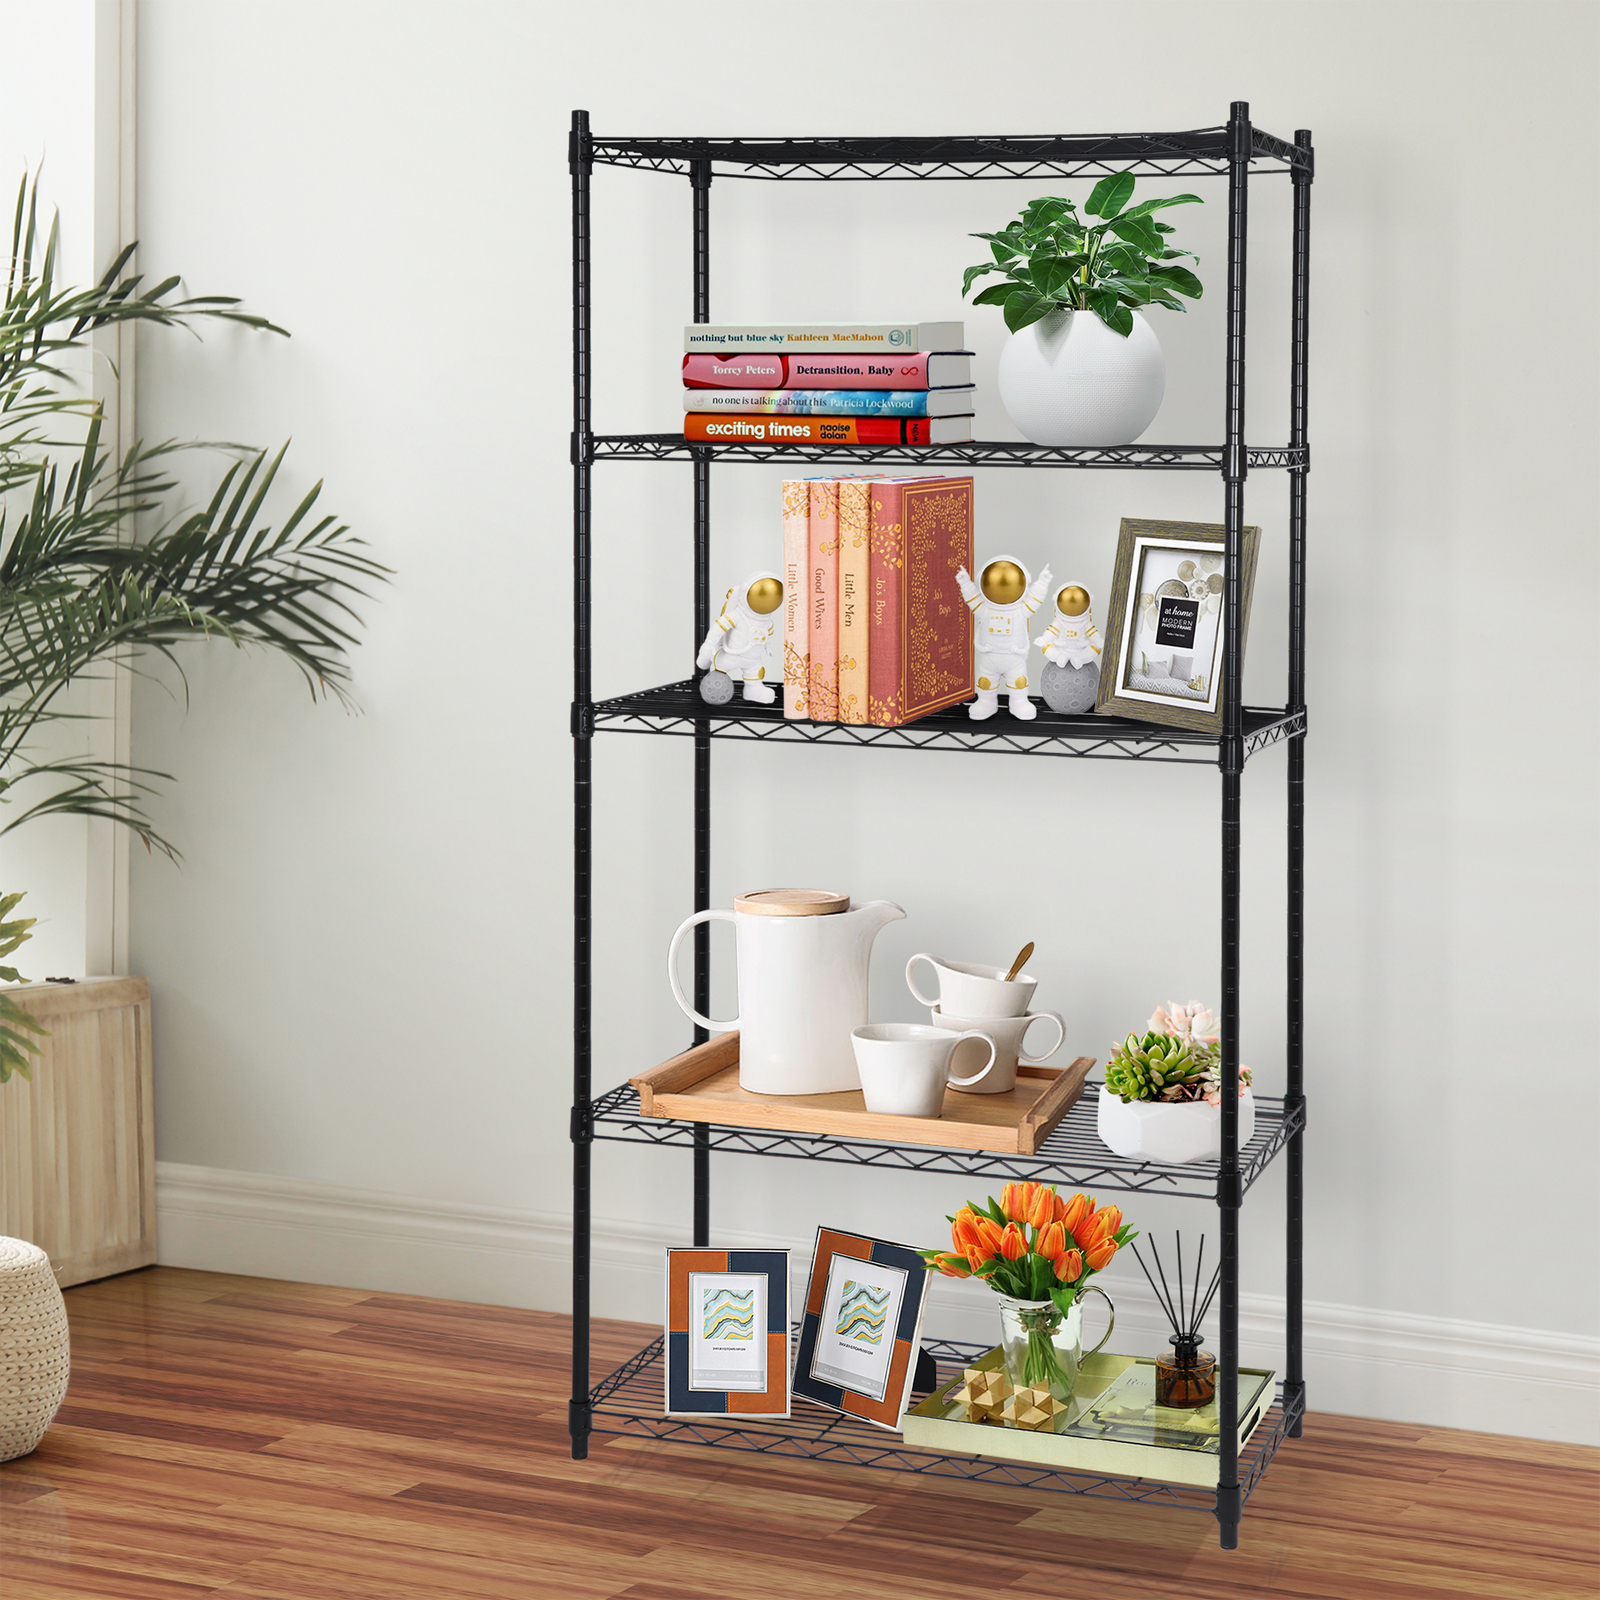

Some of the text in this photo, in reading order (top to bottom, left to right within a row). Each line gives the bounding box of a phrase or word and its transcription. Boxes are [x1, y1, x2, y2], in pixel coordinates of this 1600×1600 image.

[690, 333, 884, 344] nothing but blue sky Kathleen MacMahon
[712, 365, 895, 377] Torrey Peters Detransition, Baby
[712, 396, 914, 409] no one is talking about this Patricia Lockwood
[706, 421, 811, 440] exciting times
[819, 424, 850, 432] naoise
[819, 431, 847, 440] dolan
[788, 564, 798, 632] Little Women
[815, 568, 825, 630] Good Wives
[845, 573, 855, 627] Little Men
[873, 577, 886, 626] Jo's Boys
[939, 604, 951, 617] Boys
[1172, 605, 1194, 617] home
[1162, 617, 1193, 627] MODERN
